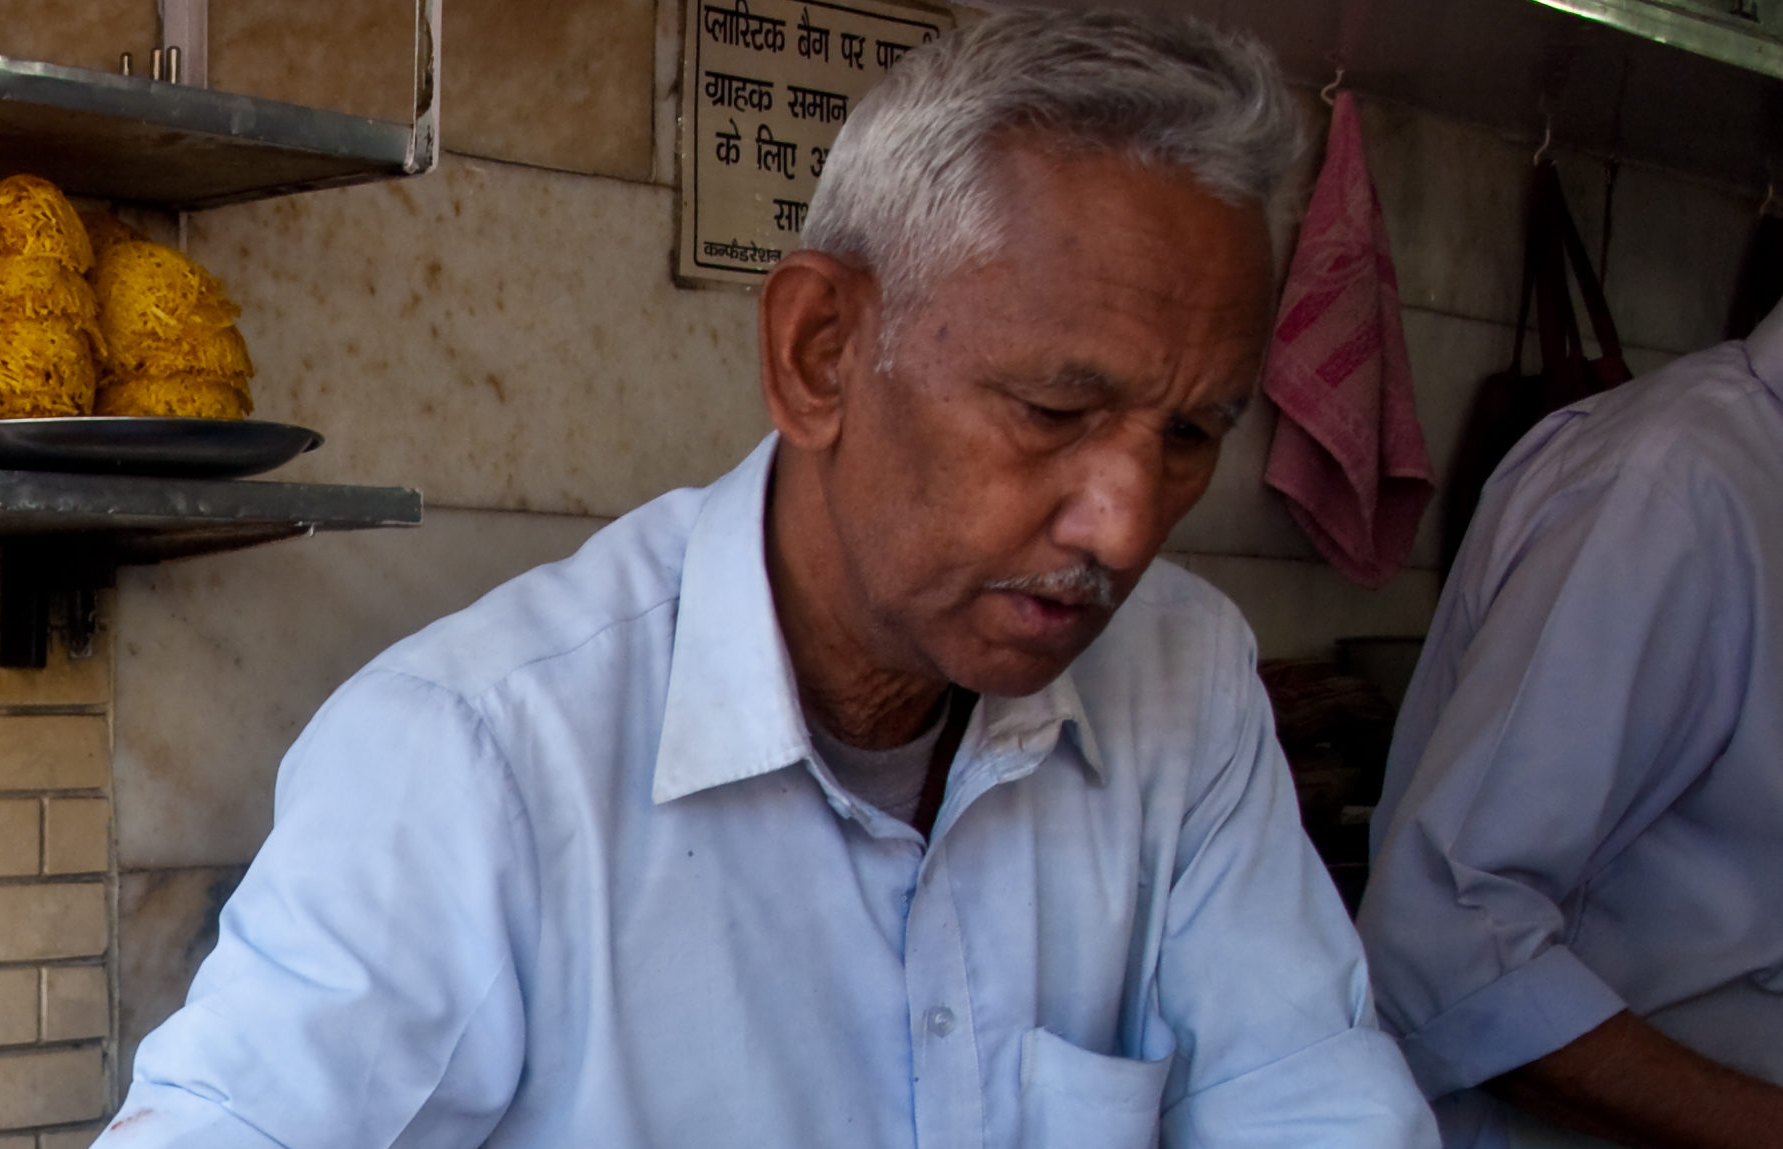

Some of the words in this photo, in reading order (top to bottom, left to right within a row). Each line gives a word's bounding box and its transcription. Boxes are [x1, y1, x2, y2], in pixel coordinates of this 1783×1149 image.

[704, 0, 786, 53] प्लास्टिक
[797, 6, 830, 63] बैग
[840, 32, 866, 70] पर
[705, 70, 774, 112] ग्राहक
[787, 85, 849, 124] समान
[715, 118, 742, 166] के
[755, 123, 797, 180] लिए
